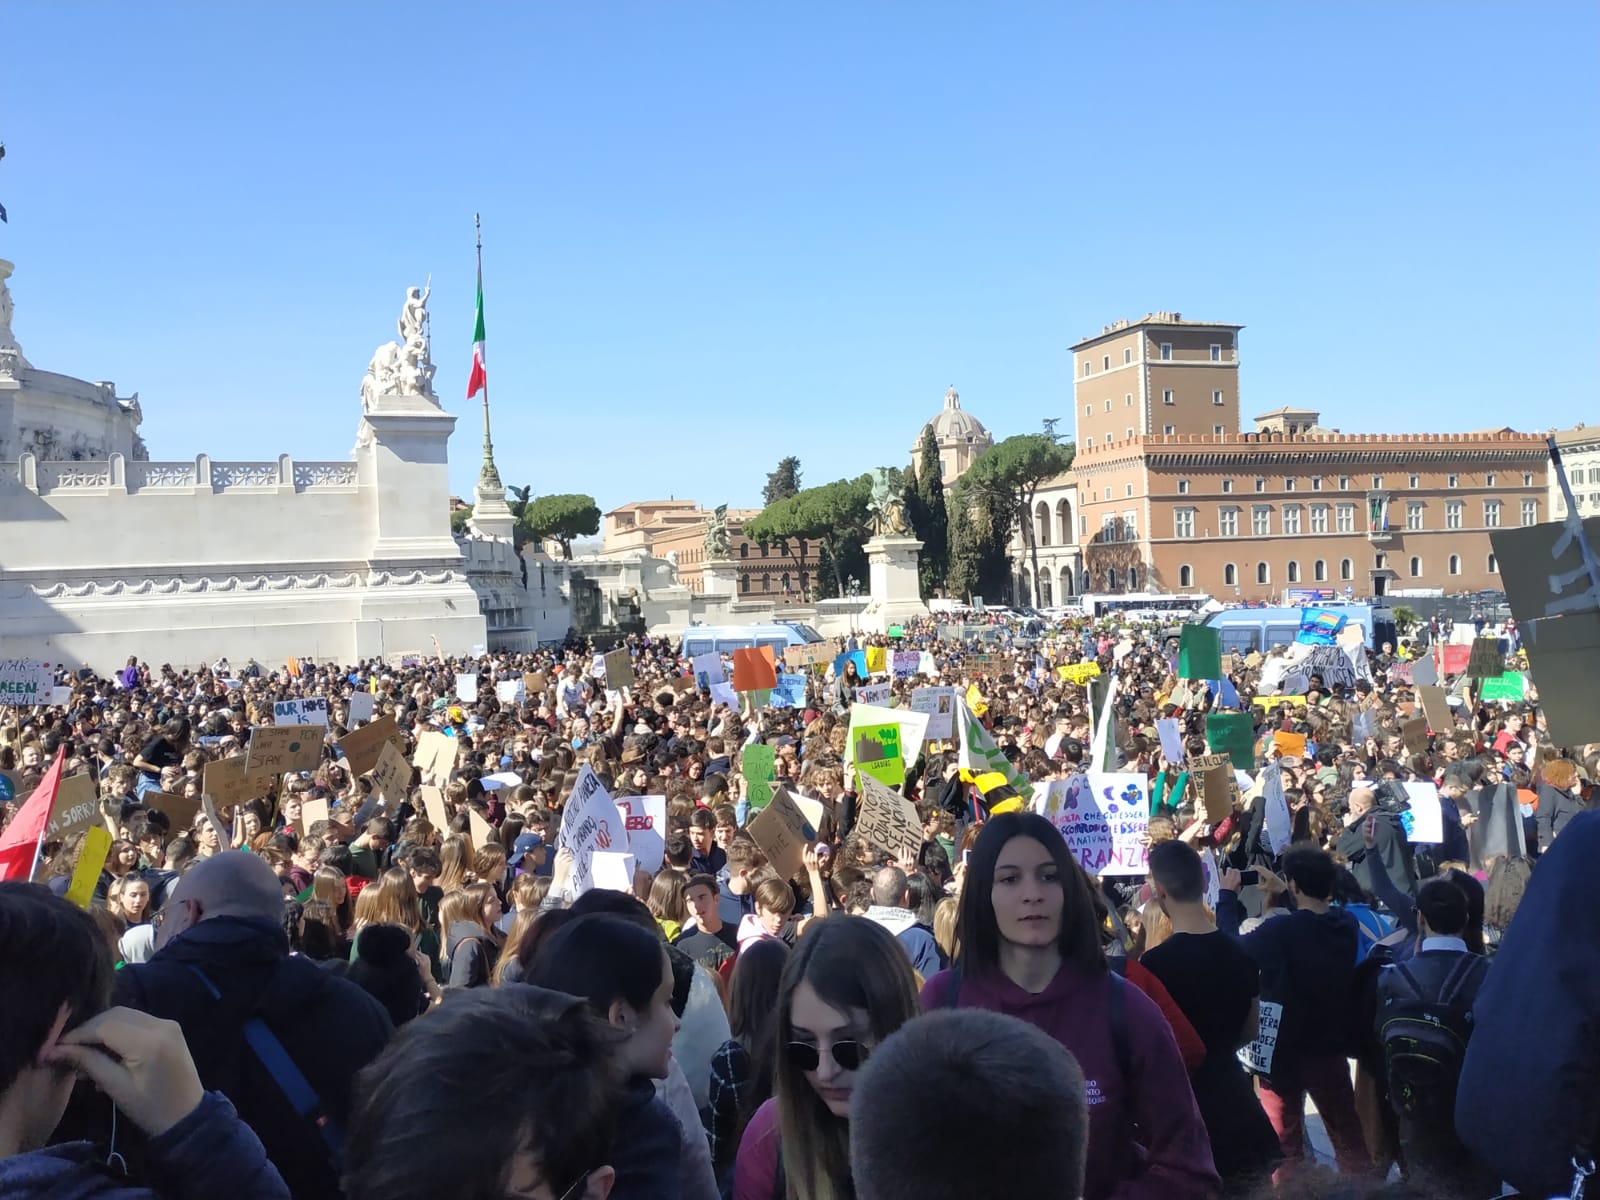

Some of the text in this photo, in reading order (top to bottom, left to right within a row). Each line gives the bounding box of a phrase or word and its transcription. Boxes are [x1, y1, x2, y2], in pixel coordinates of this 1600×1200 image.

[0, 681, 37, 693] REEN
[275, 699, 326, 716] OUR HOME
[62, 799, 97, 827] SORRY
[1084, 812, 1101, 821] CHE
[625, 815, 654, 831] EBO
[1071, 847, 1149, 869] RANZA
[1260, 1007, 1272, 1016] IEZ
[1248, 1051, 1267, 1067] RUE
